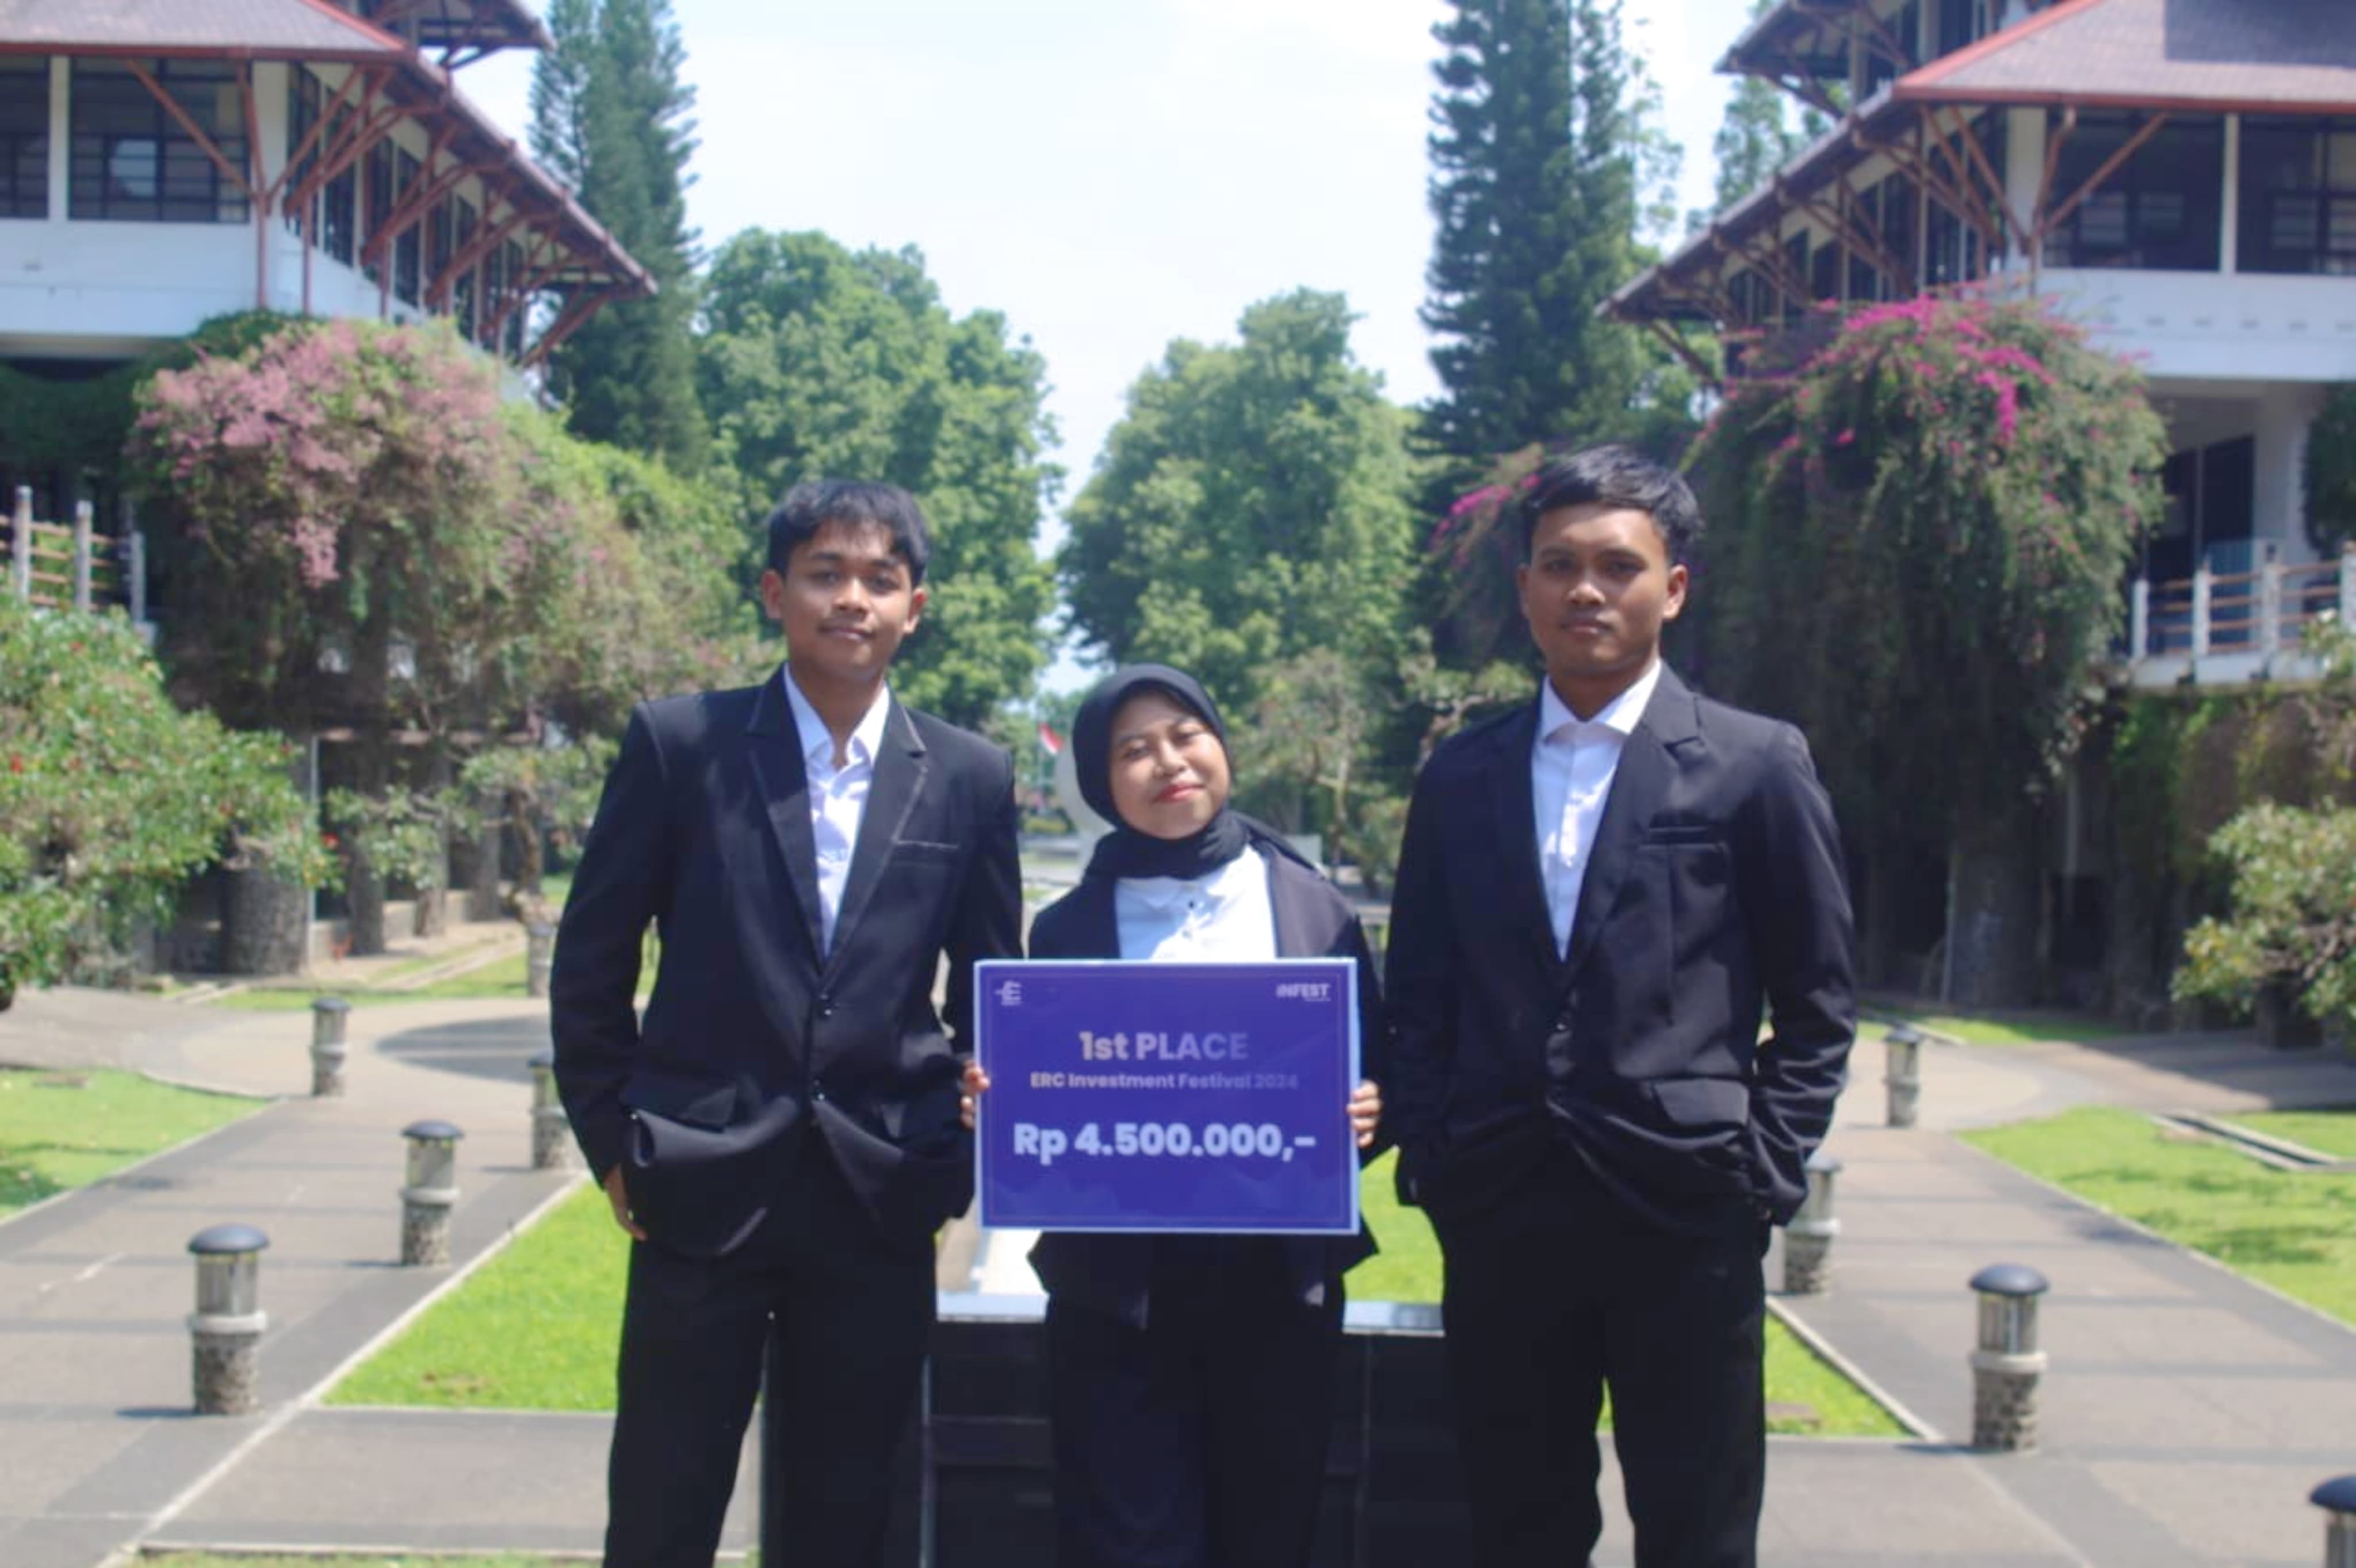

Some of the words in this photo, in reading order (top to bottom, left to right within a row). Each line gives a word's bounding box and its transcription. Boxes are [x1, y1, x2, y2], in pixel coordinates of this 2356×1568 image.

[1078, 1031, 1129, 1061] 1st
[1135, 1032, 1248, 1061] PLACE
[1068, 1073, 1176, 1088] Investment
[1179, 1072, 1252, 1088] Festival
[1255, 1073, 1298, 1088] 2024
[1014, 1123, 1067, 1165] Rp
